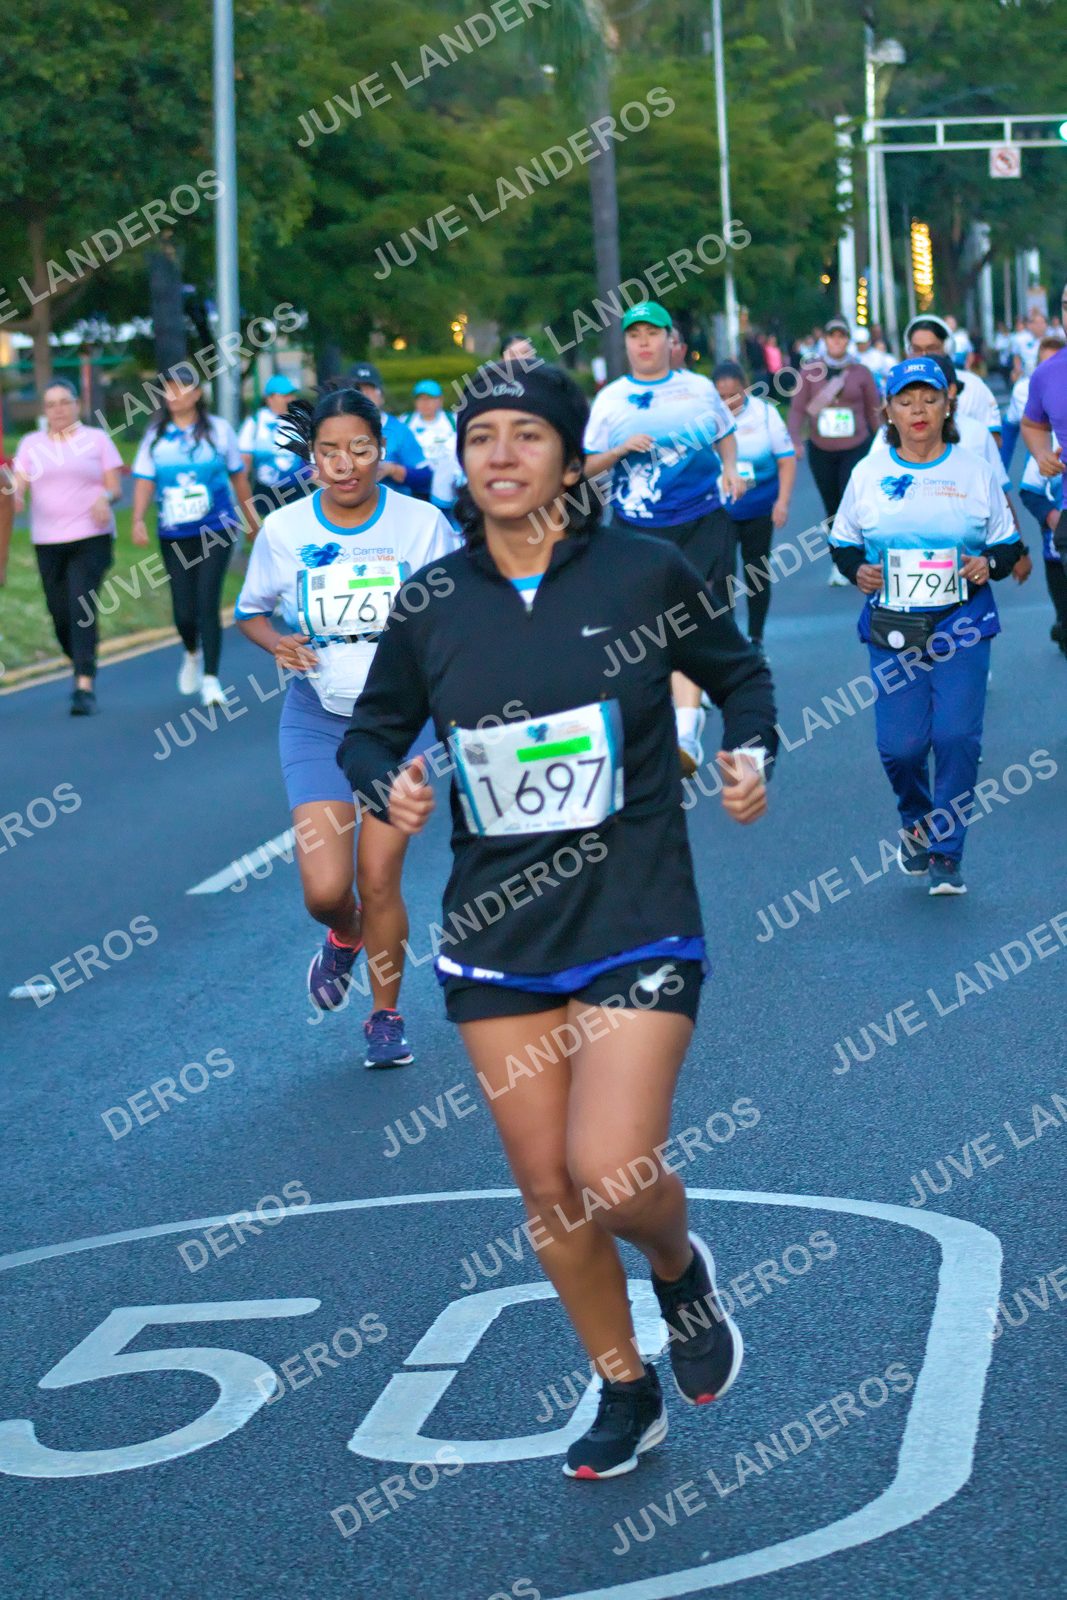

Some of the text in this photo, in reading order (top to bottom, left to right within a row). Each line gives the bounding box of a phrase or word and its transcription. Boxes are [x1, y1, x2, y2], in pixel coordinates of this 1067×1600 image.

[353, 547, 394, 556] Carrera
[893, 571, 957, 598] 1794
[315, 591, 392, 628] 1761
[478, 756, 606, 819] 1697
